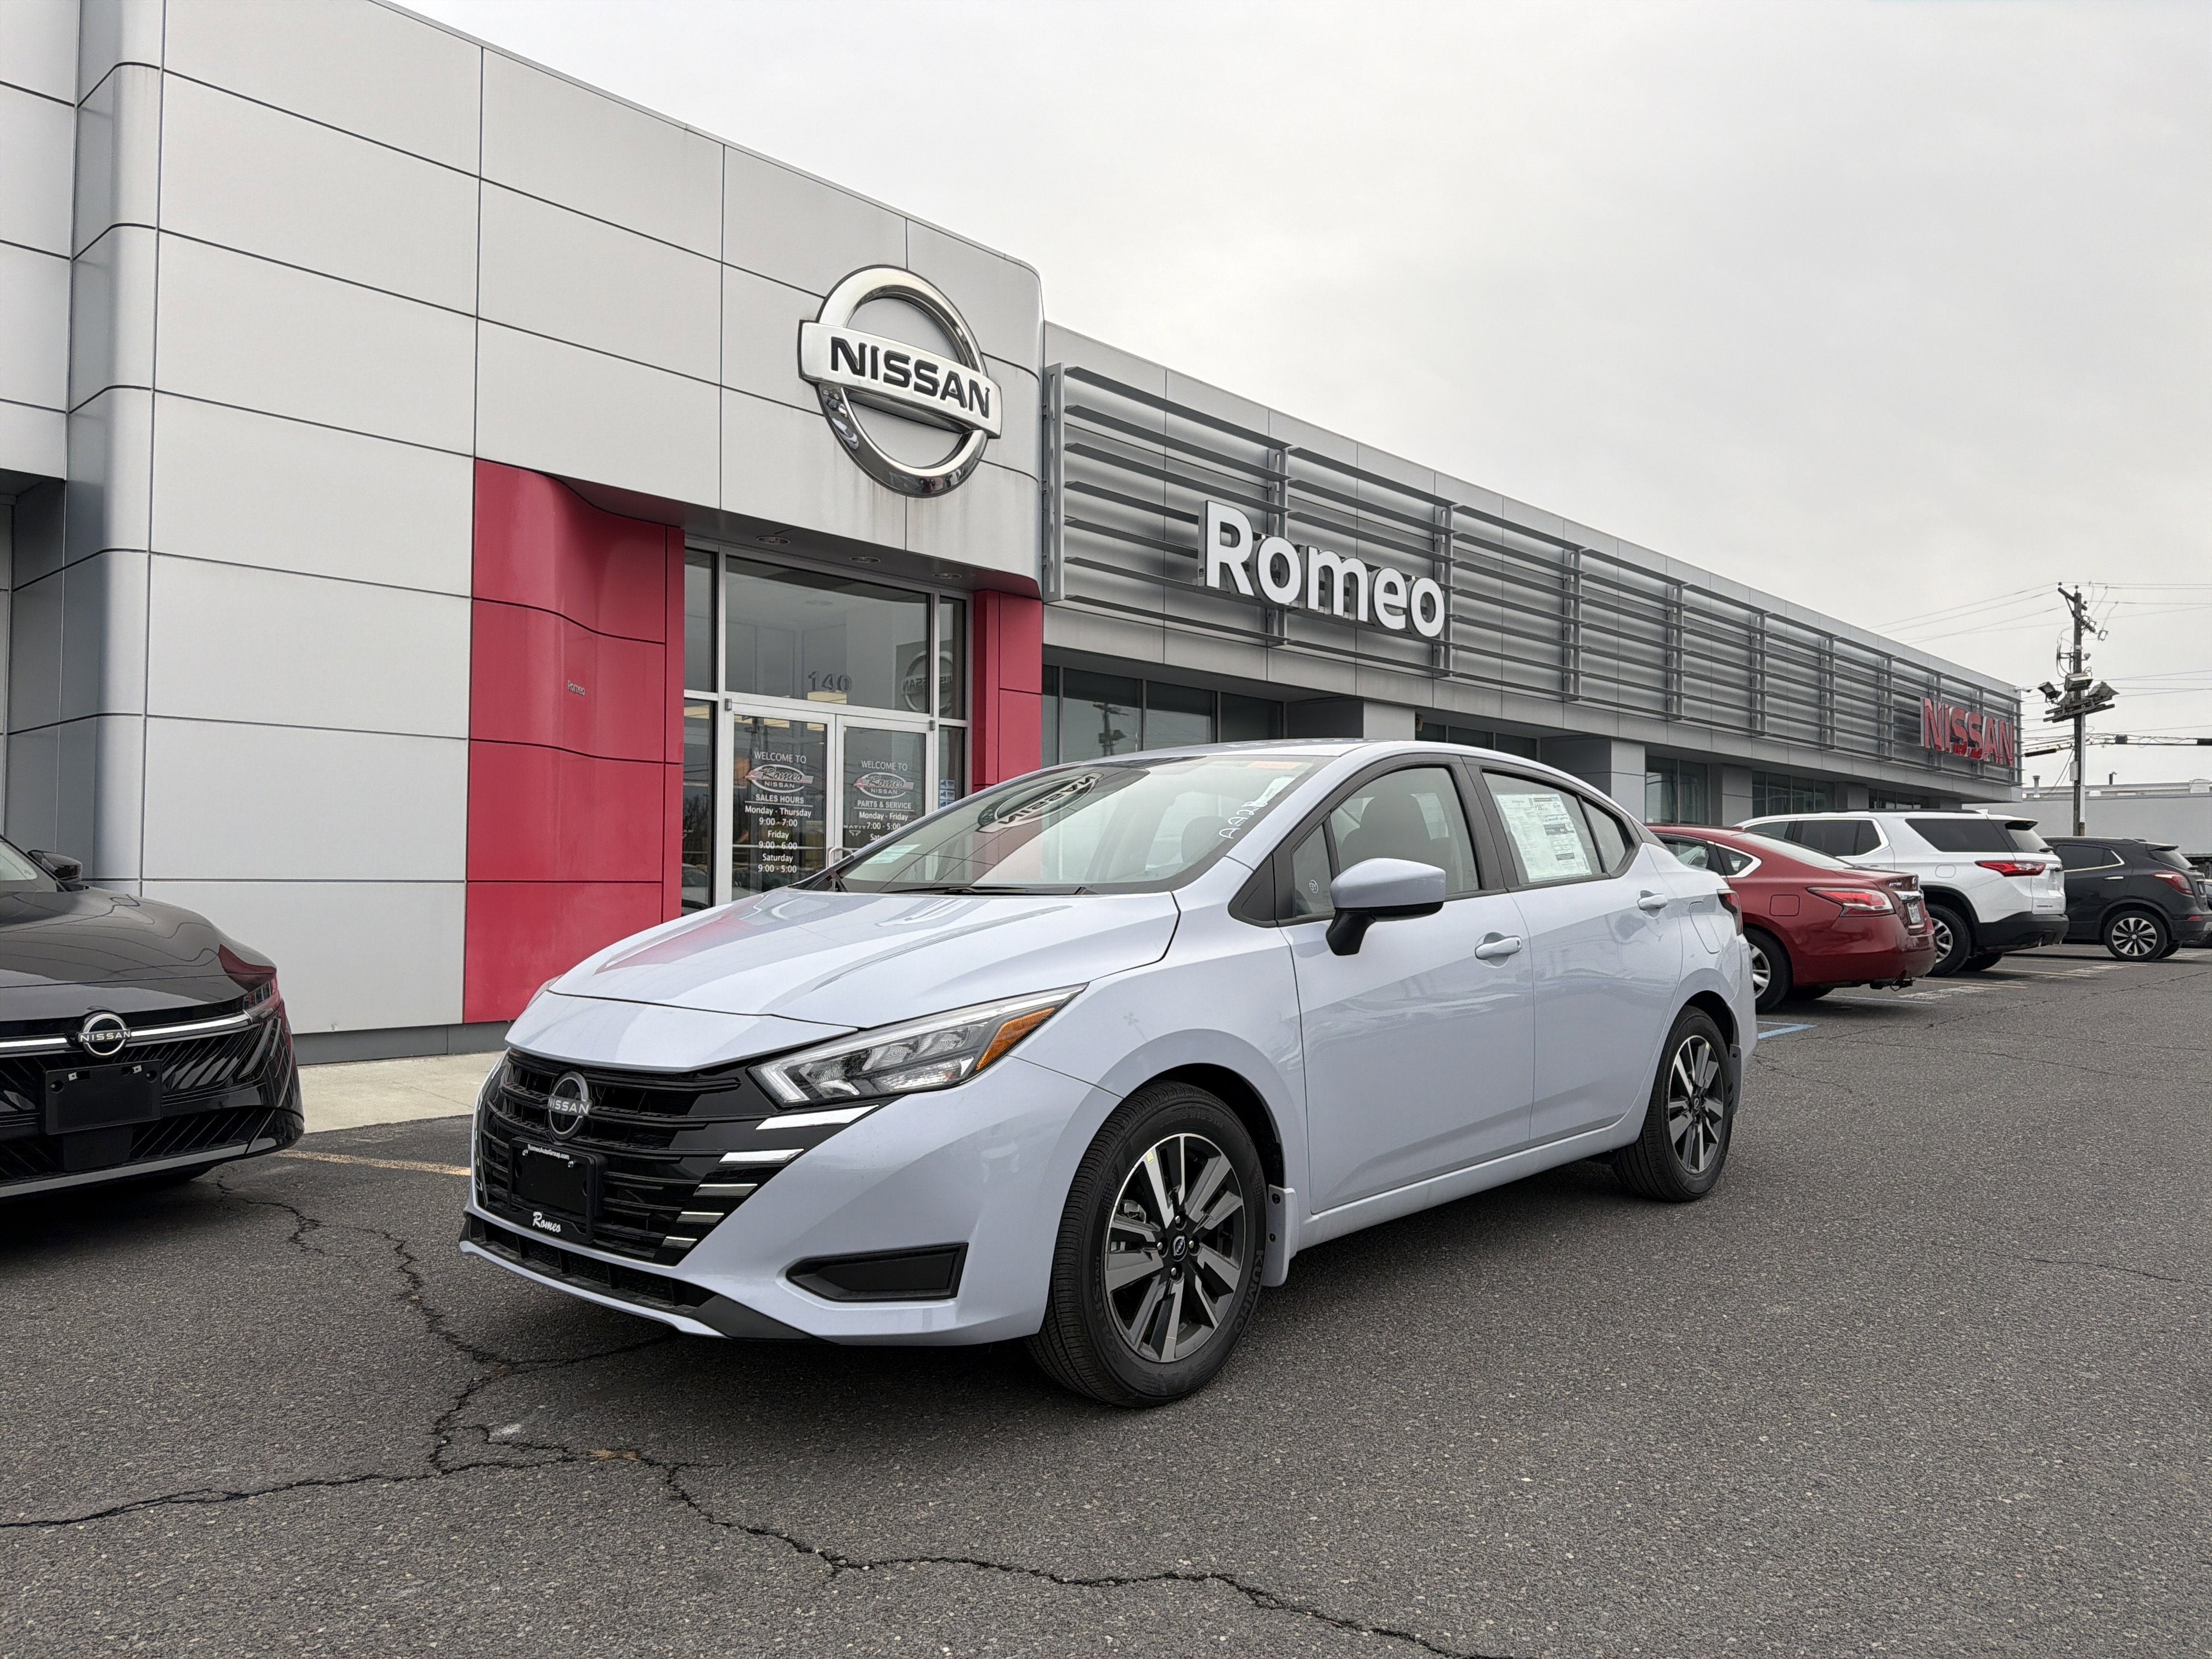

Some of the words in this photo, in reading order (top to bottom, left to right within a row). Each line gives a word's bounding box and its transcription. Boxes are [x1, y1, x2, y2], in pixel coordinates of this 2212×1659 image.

[830, 336, 990, 419] NISSAN
[1205, 499, 1446, 638] Romeo
[808, 671, 852, 691] 140
[567, 680, 585, 696] Romeo
[1922, 697, 2015, 767] NISSAN
[754, 751, 793, 762] WELCOME
[795, 755, 806, 764] TO
[861, 760, 896, 770] WELCOME
[898, 763, 908, 771] TO
[758, 766, 803, 781] Romeo
[866, 774, 904, 787] Romeo
[755, 794, 778, 803] SALES
[780, 795, 804, 804] HOURS
[745, 805, 774, 816] Monday
[780, 808, 812, 819] Thursday
[859, 811, 884, 821] Monday
[889, 812, 909, 822] Friday
[759, 817, 775, 826] 9:00
[782, 819, 798, 827] 7:00
[768, 830, 789, 840] Friday
[758, 841, 775, 849] 9:00
[781, 842, 798, 850] 6:00
[762, 853, 793, 863] Saturday
[758, 864, 775, 872] 9:00
[781, 865, 797, 873] 5:00
[80, 1031, 130, 1042] NISSAN
[548, 1097, 590, 1114] NISSAN
[527, 1144, 569, 1160] RomeoAutoGroup.com
[533, 1211, 561, 1233] Romeo
[1234, 1250, 1264, 1334] KUMHO
